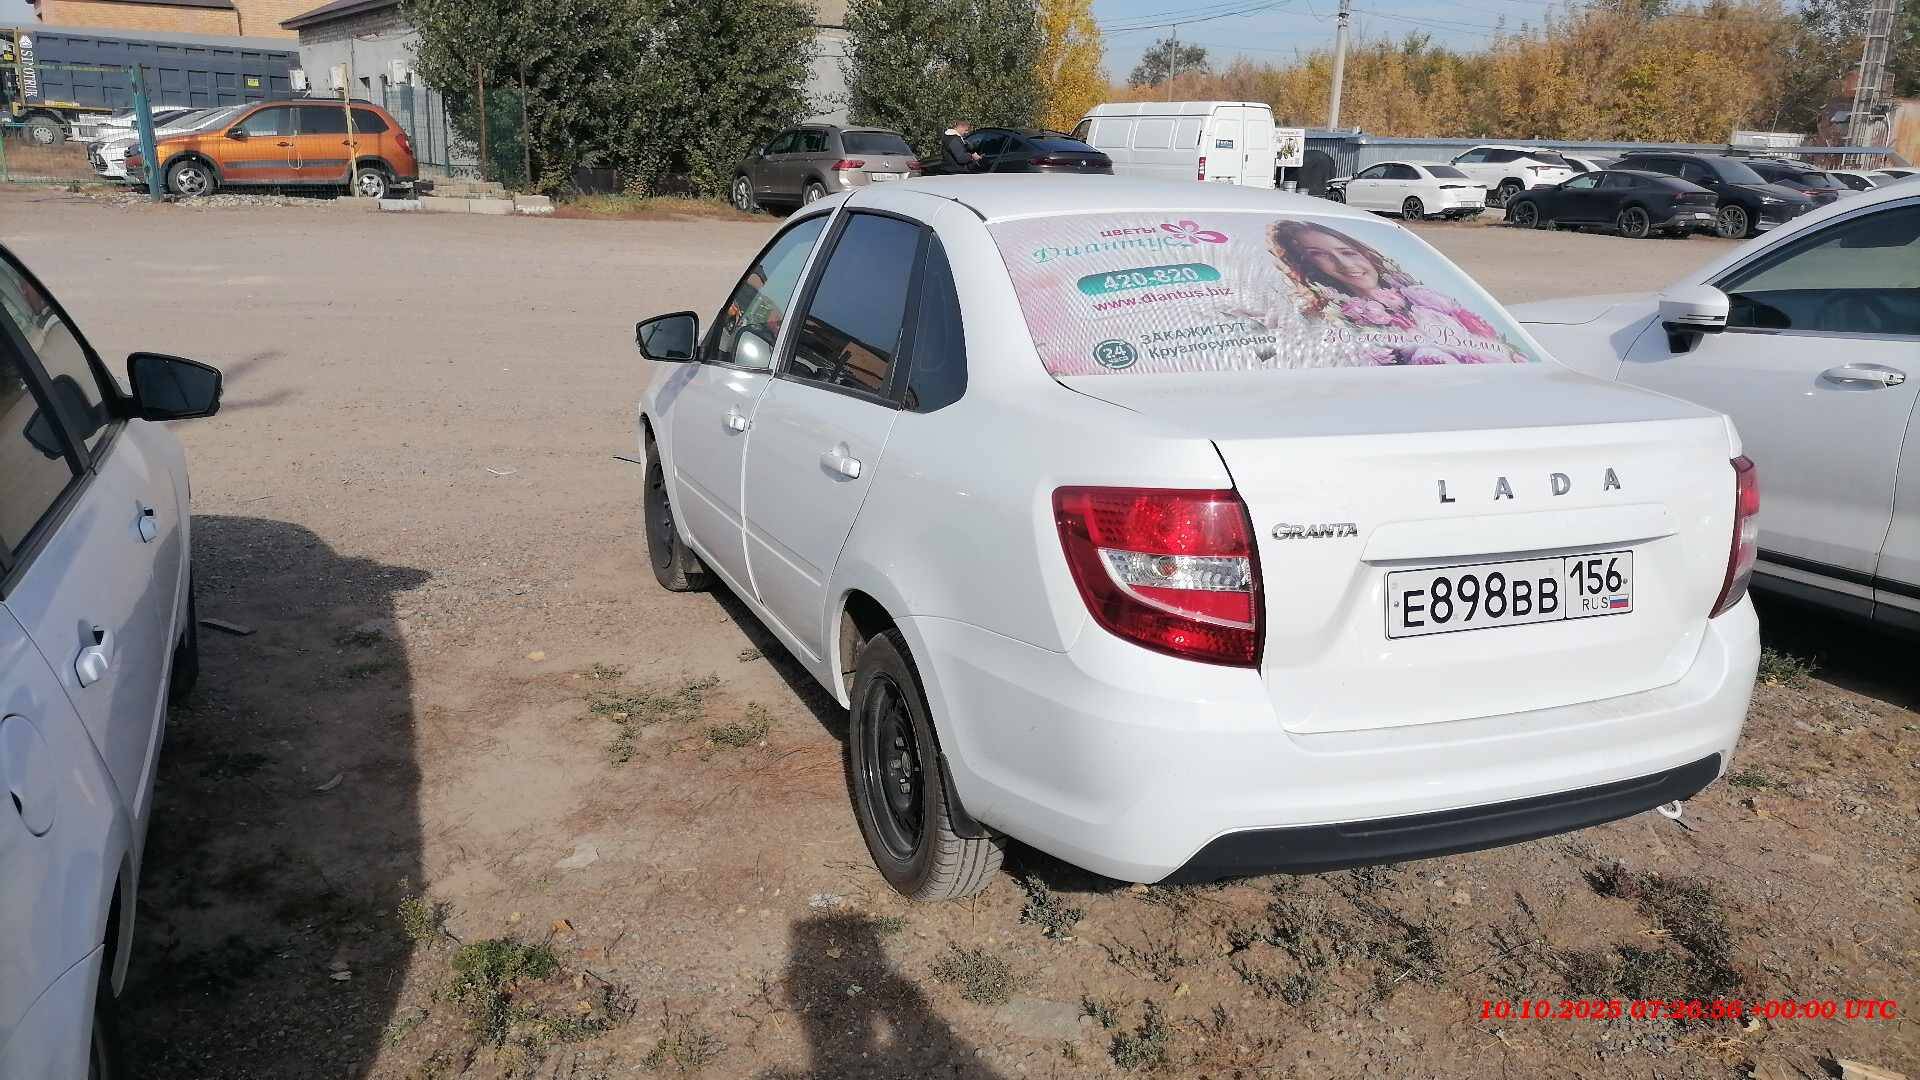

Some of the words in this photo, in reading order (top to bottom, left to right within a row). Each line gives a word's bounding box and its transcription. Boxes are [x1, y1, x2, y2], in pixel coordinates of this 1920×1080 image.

[1100, 227, 1156, 237] ЦВЕТЫ
[1032, 235, 1193, 264] Диантус
[1104, 267, 1200, 290] 420-820
[1092, 286, 1234, 312] www.diantus.biz
[1140, 325, 1213, 345] ЗАКАЖИ
[1216, 322, 1247, 335] ТУТ
[1102, 345, 1127, 359] 24
[1148, 335, 1277, 360] Круглосуточно
[1438, 467, 1622, 504] LADA
[1271, 522, 1359, 541] GRANTA
[1569, 557, 1623, 596] 156
[1582, 596, 1609, 612] RUS
